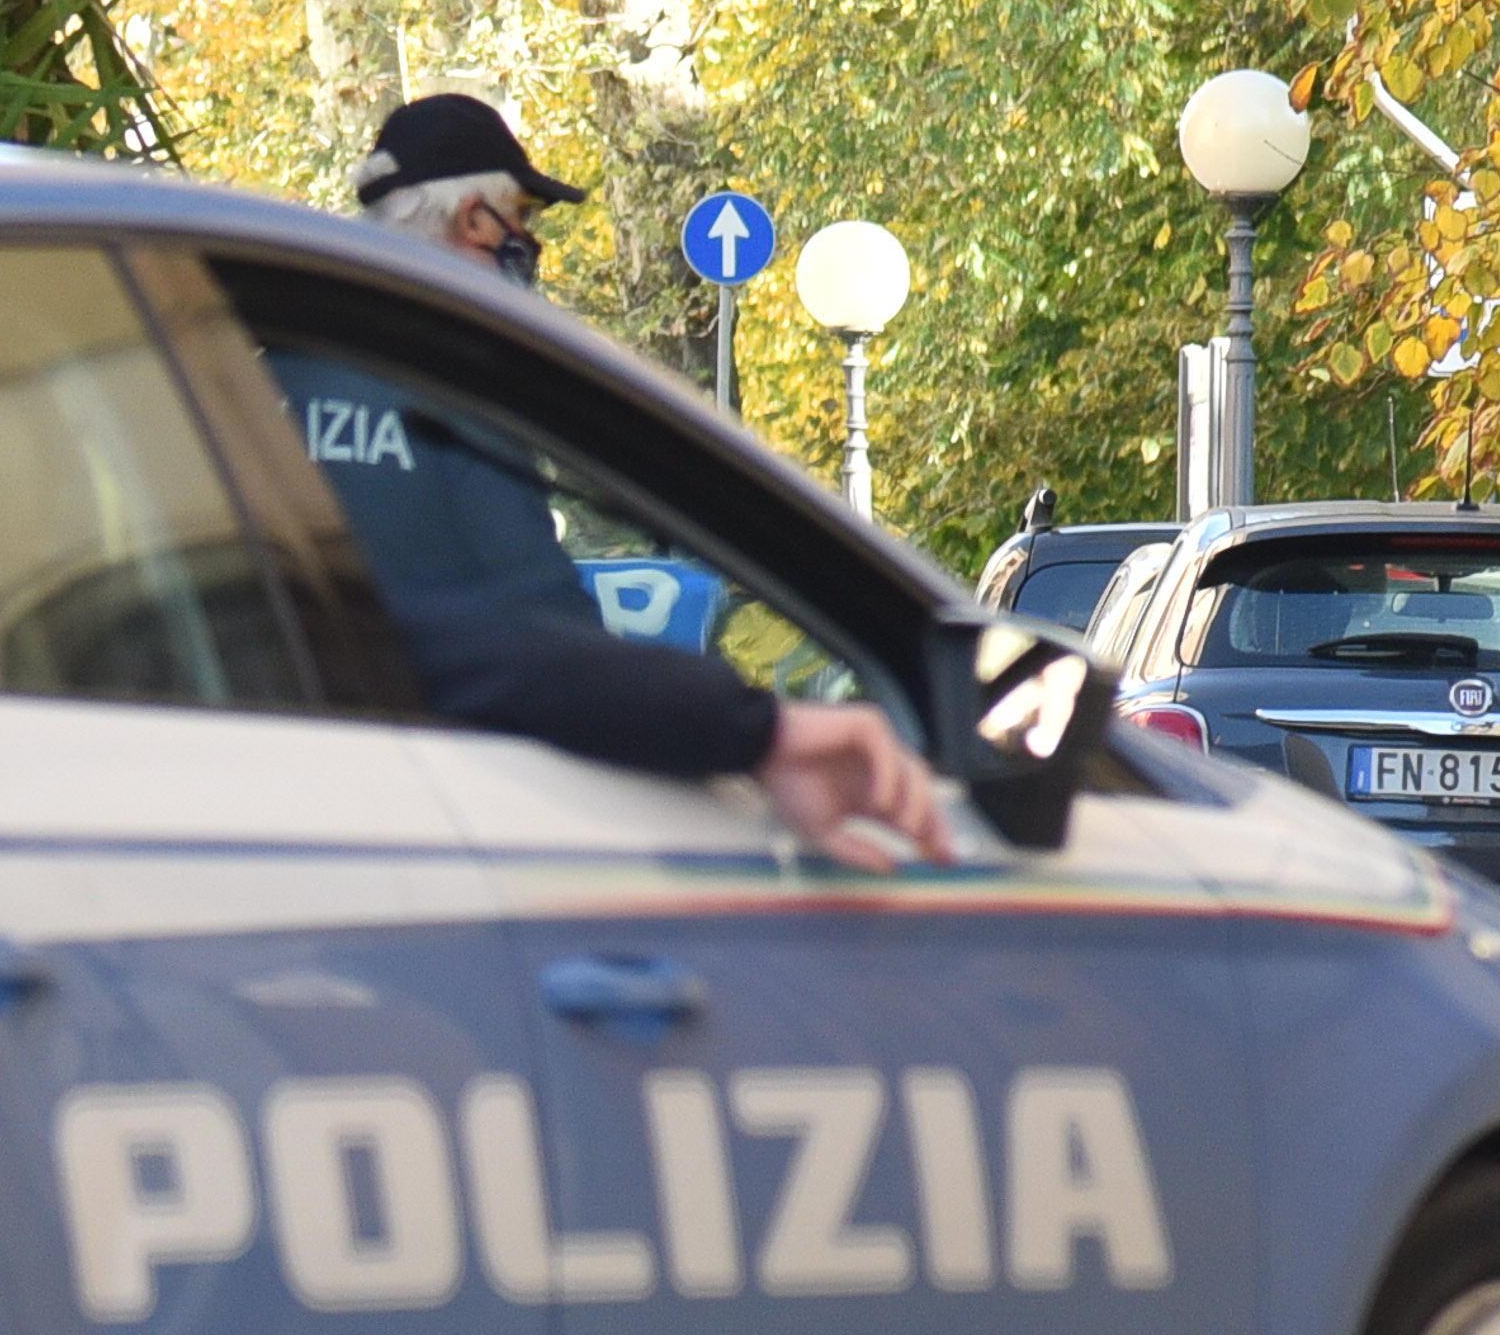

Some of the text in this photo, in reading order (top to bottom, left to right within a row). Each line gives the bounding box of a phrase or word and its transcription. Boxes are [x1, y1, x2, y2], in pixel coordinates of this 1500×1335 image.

[306, 397, 416, 471] IZIA
[1460, 689, 1482, 706] FIAT
[1377, 751, 1424, 792] FN
[56, 1065, 1175, 1323] POLIZIA
